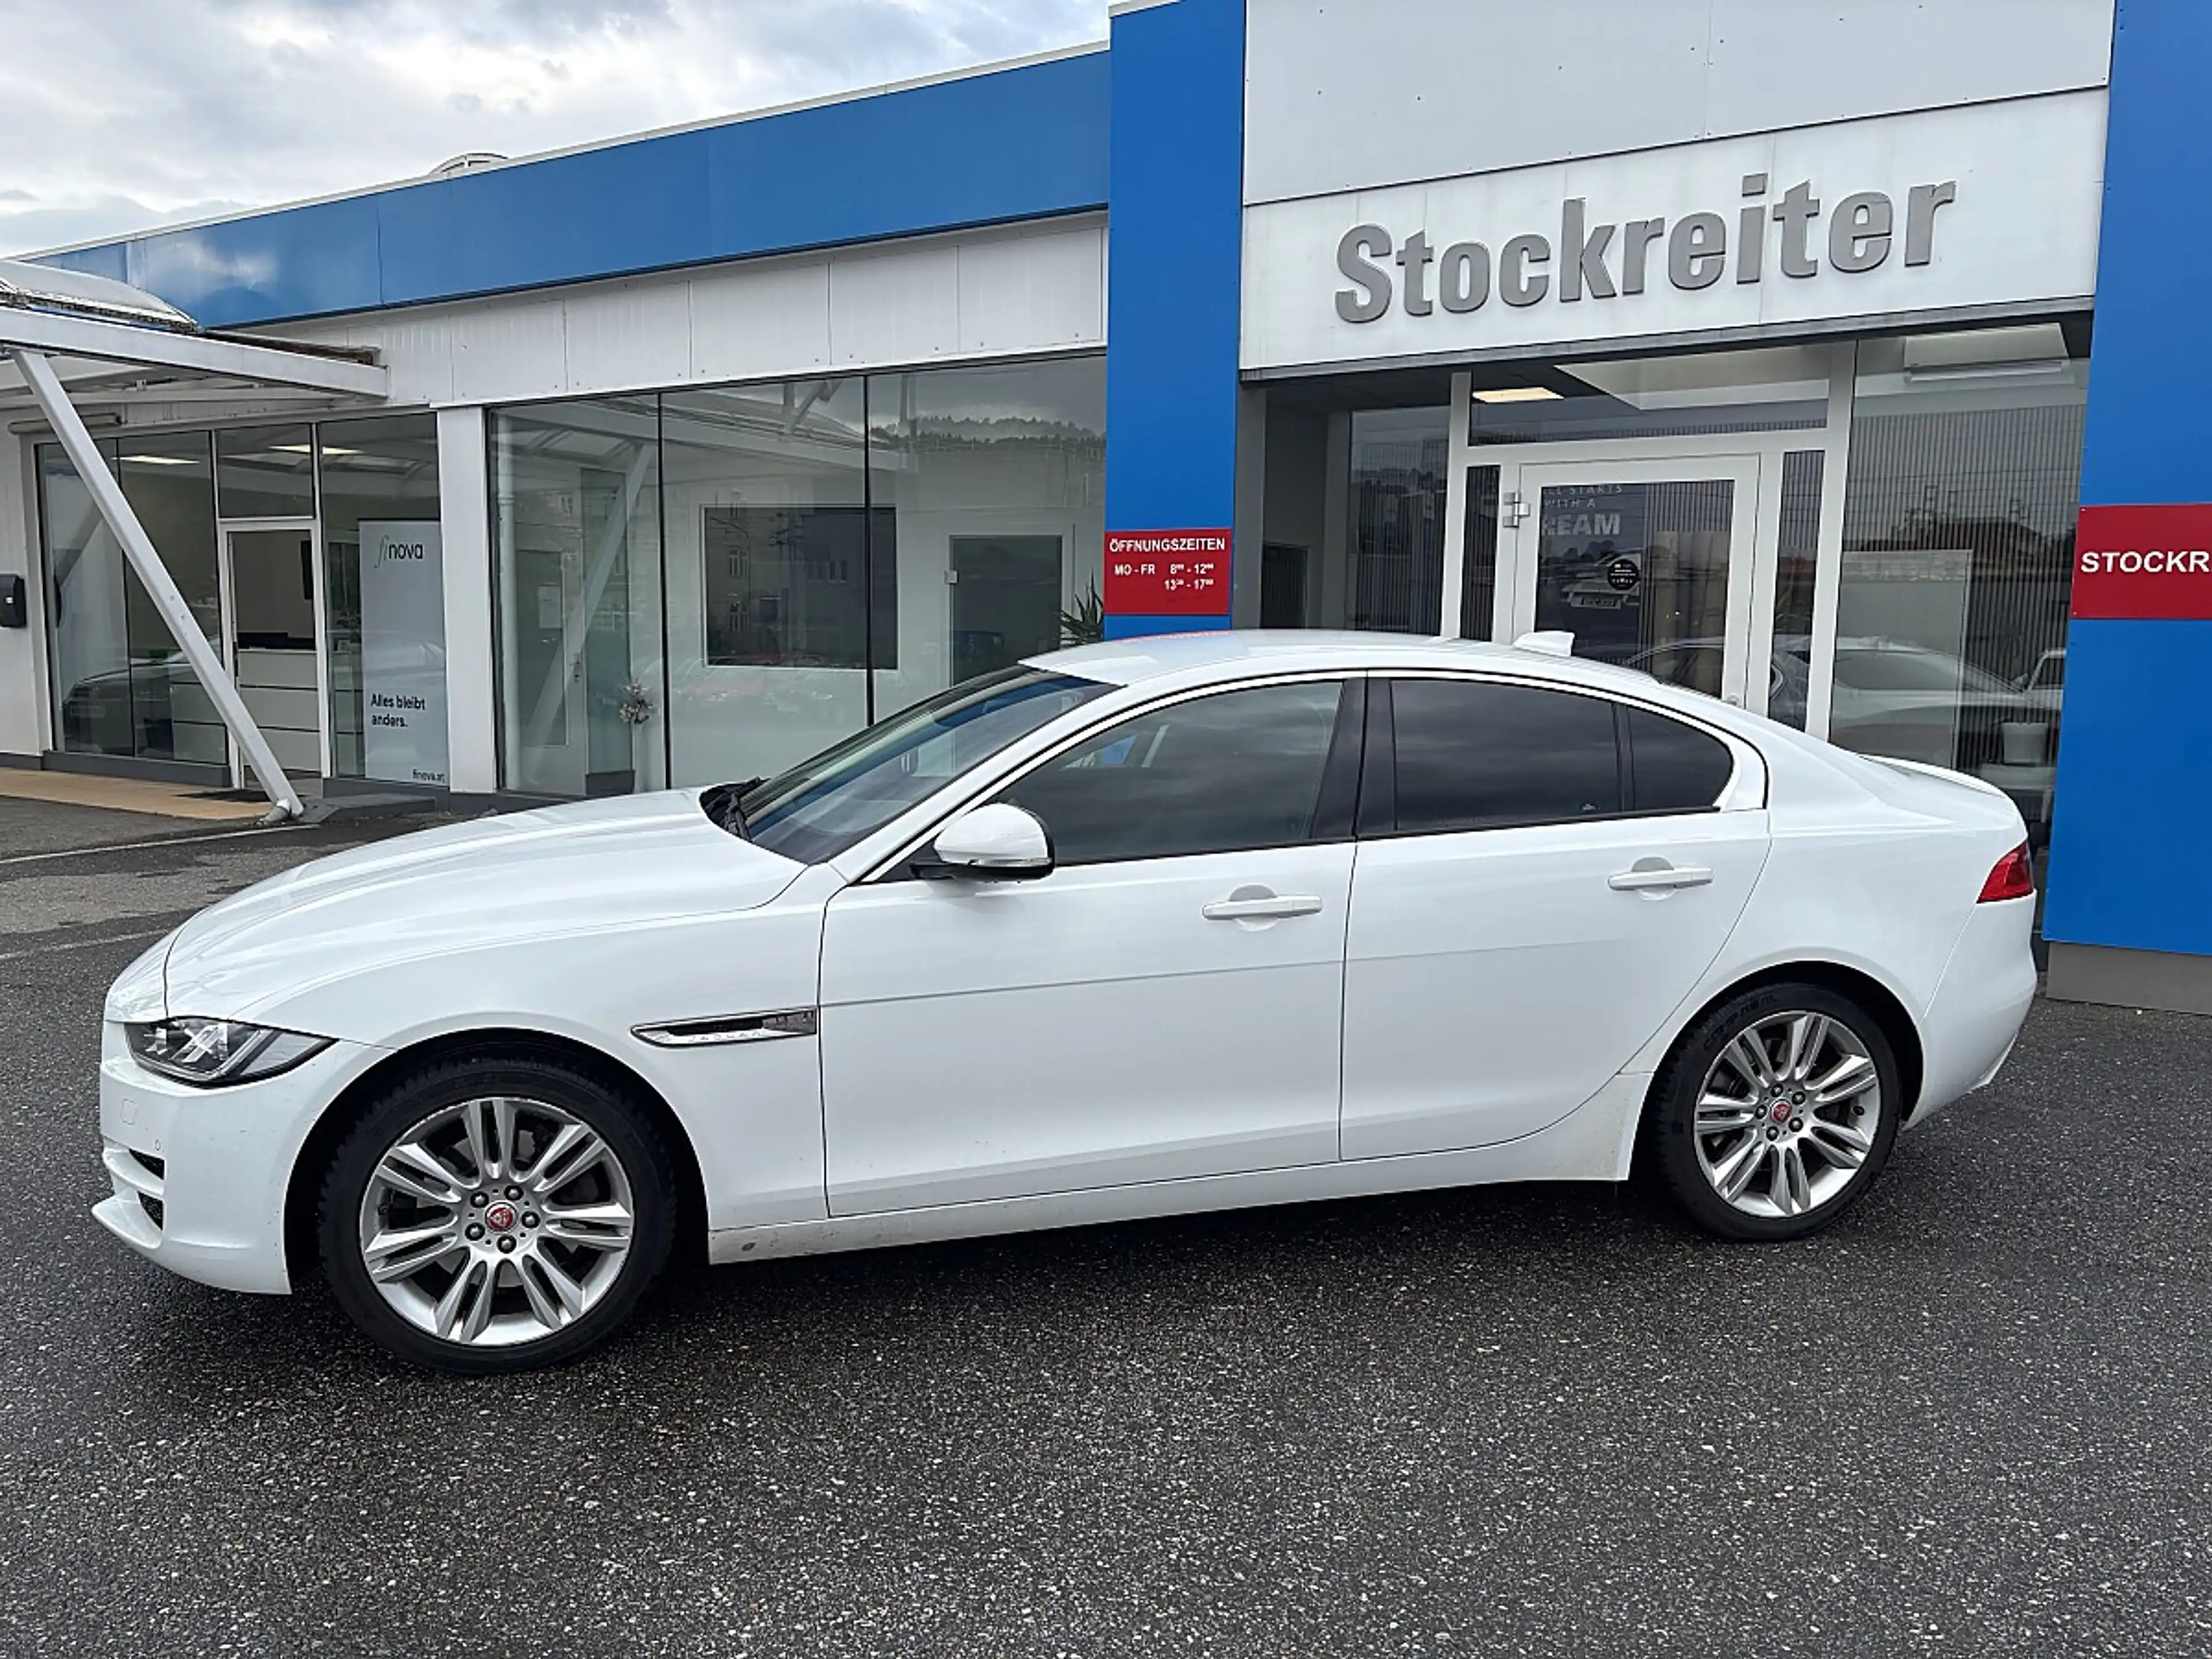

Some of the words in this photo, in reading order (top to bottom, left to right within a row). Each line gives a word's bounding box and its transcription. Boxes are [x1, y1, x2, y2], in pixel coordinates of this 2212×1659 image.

[1335, 172, 1956, 324] Stockreiter
[374, 535, 423, 569] finova
[1109, 538, 1225, 552] ÖFFNUNGSZEITEN
[1114, 564, 1132, 576] MO
[1141, 563, 1156, 575] FR
[2080, 551, 2210, 573] STOCKR
[370, 693, 395, 708] Alles
[396, 694, 426, 710] bleibt
[372, 713, 408, 728] anders.
